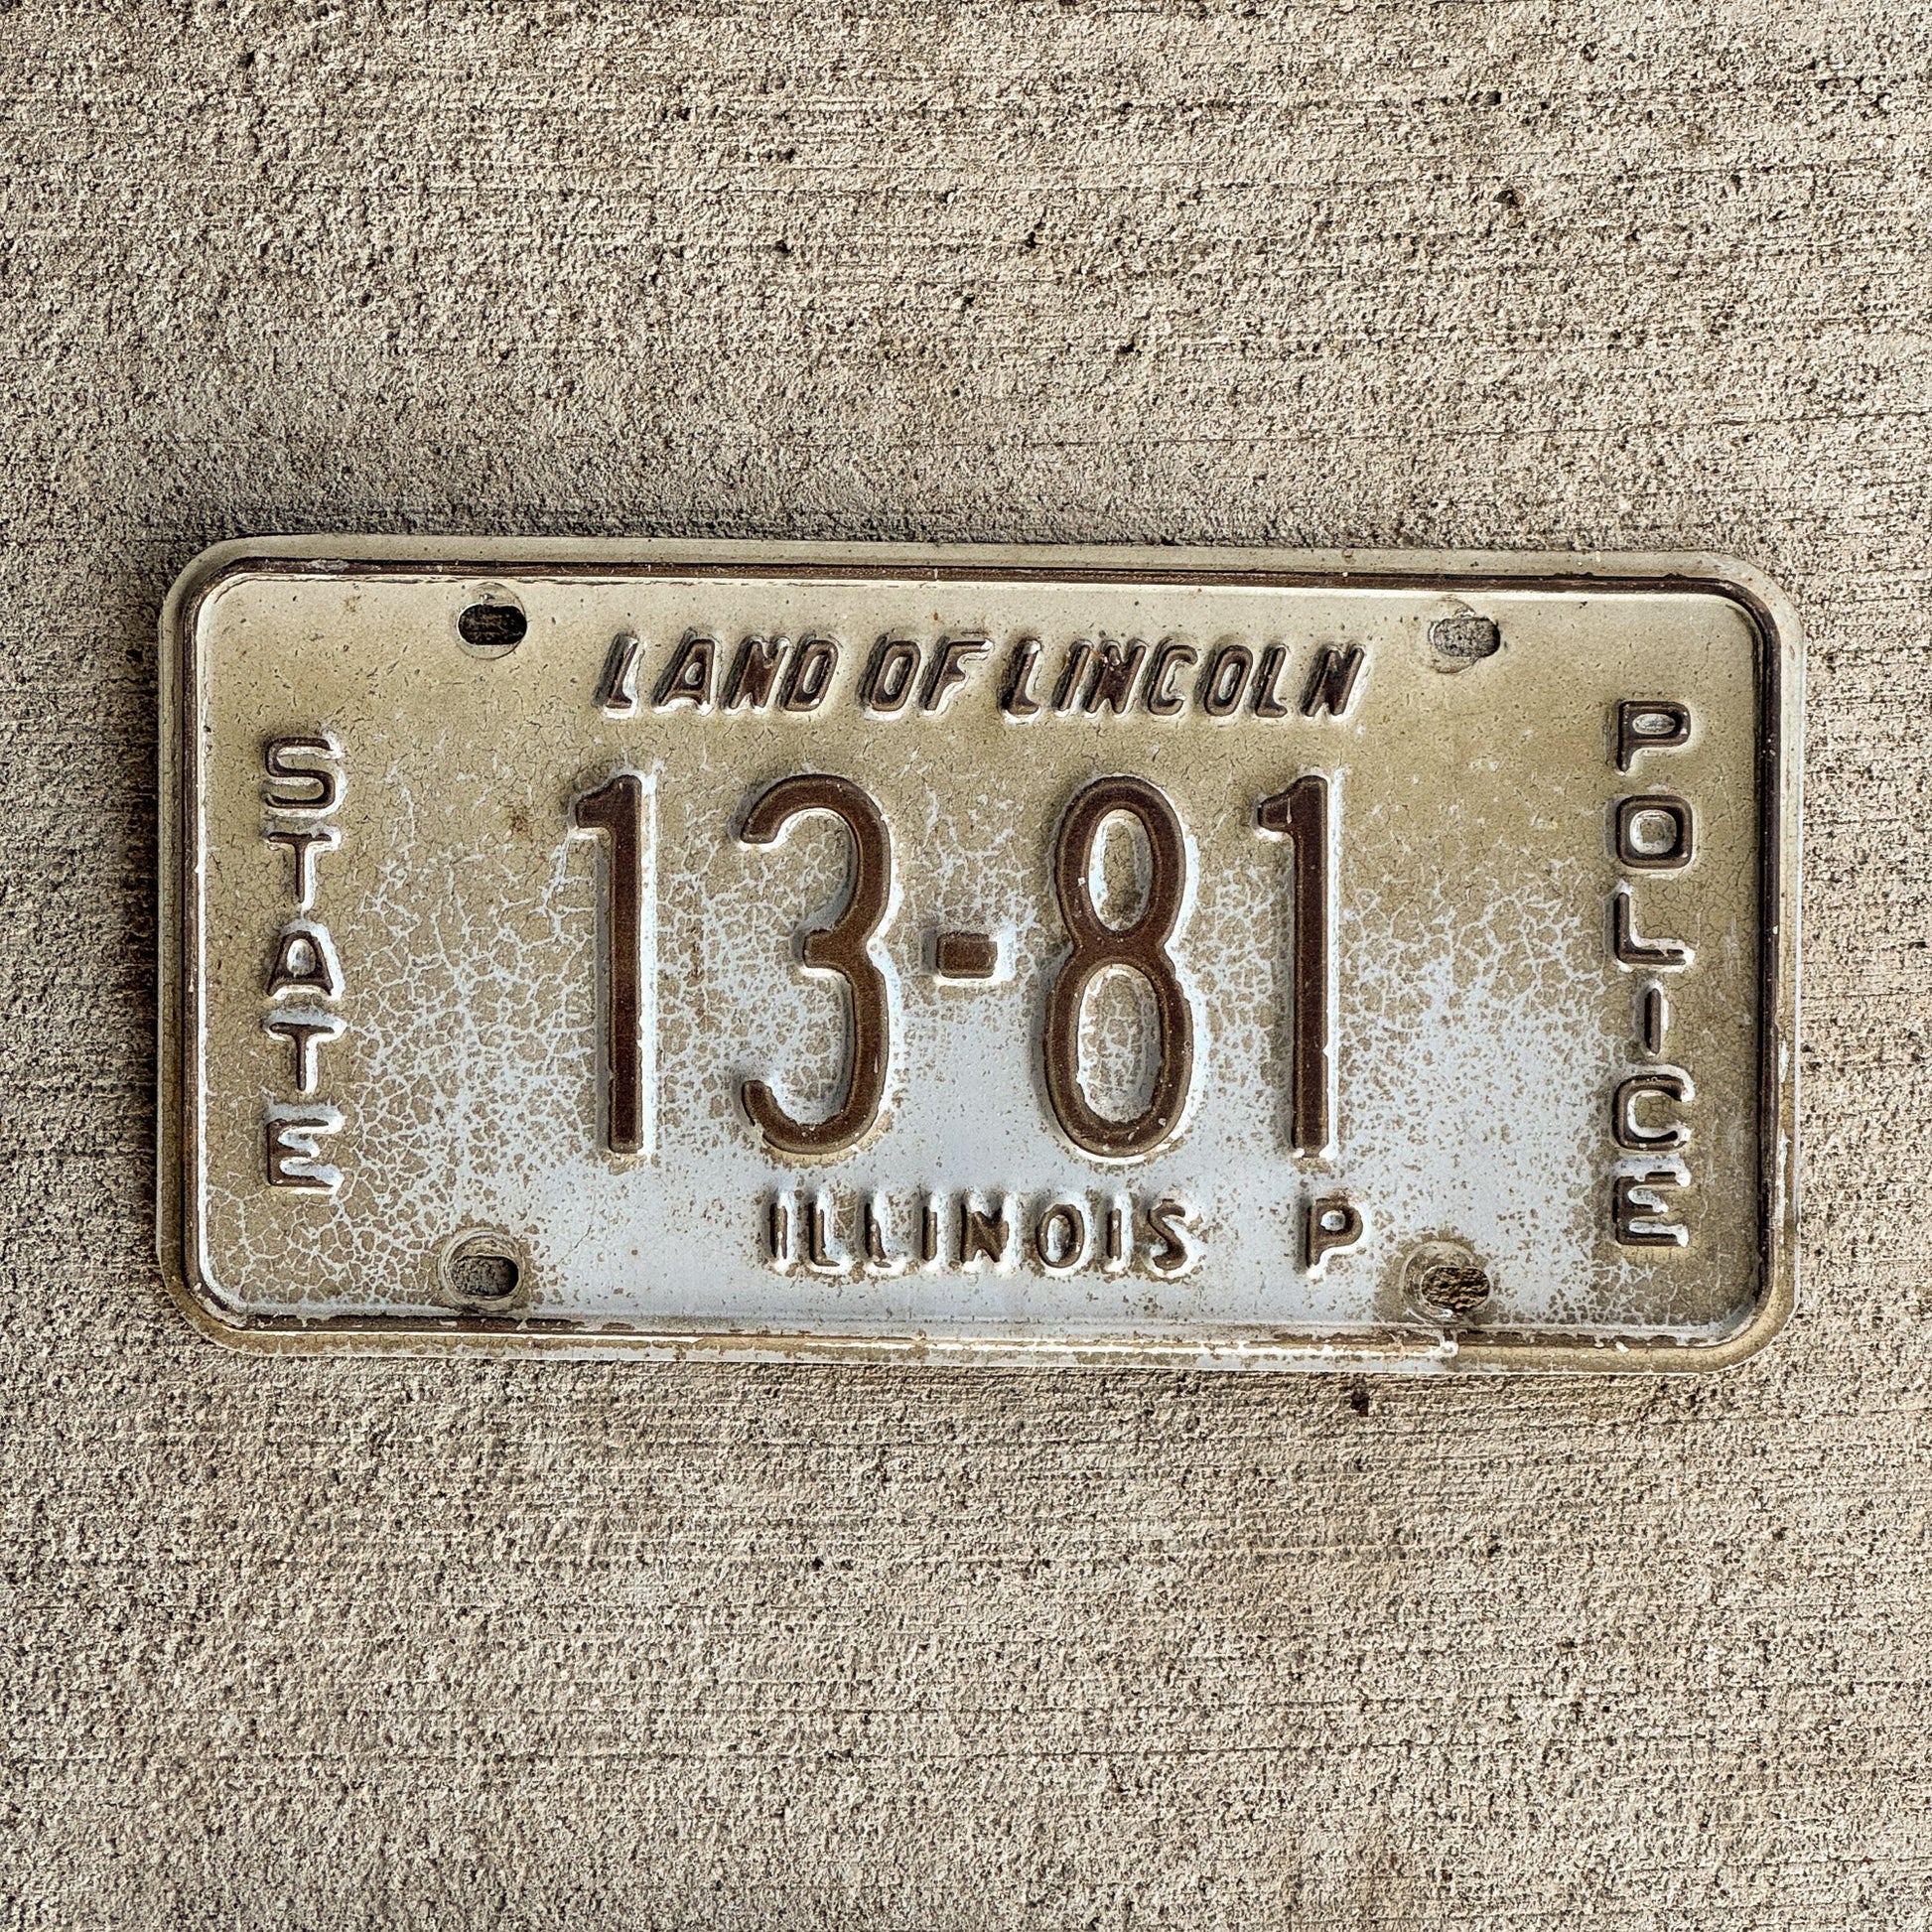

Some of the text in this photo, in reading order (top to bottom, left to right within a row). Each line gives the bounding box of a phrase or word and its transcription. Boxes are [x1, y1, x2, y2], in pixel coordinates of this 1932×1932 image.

[602, 636, 1367, 719] LAND OF LINCOLN
[264, 736, 345, 1193] STATE
[570, 771, 1340, 1161] 13-81
[1612, 699, 1694, 1249] POLICE
[767, 1193, 1365, 1275] ILLINOIS P
